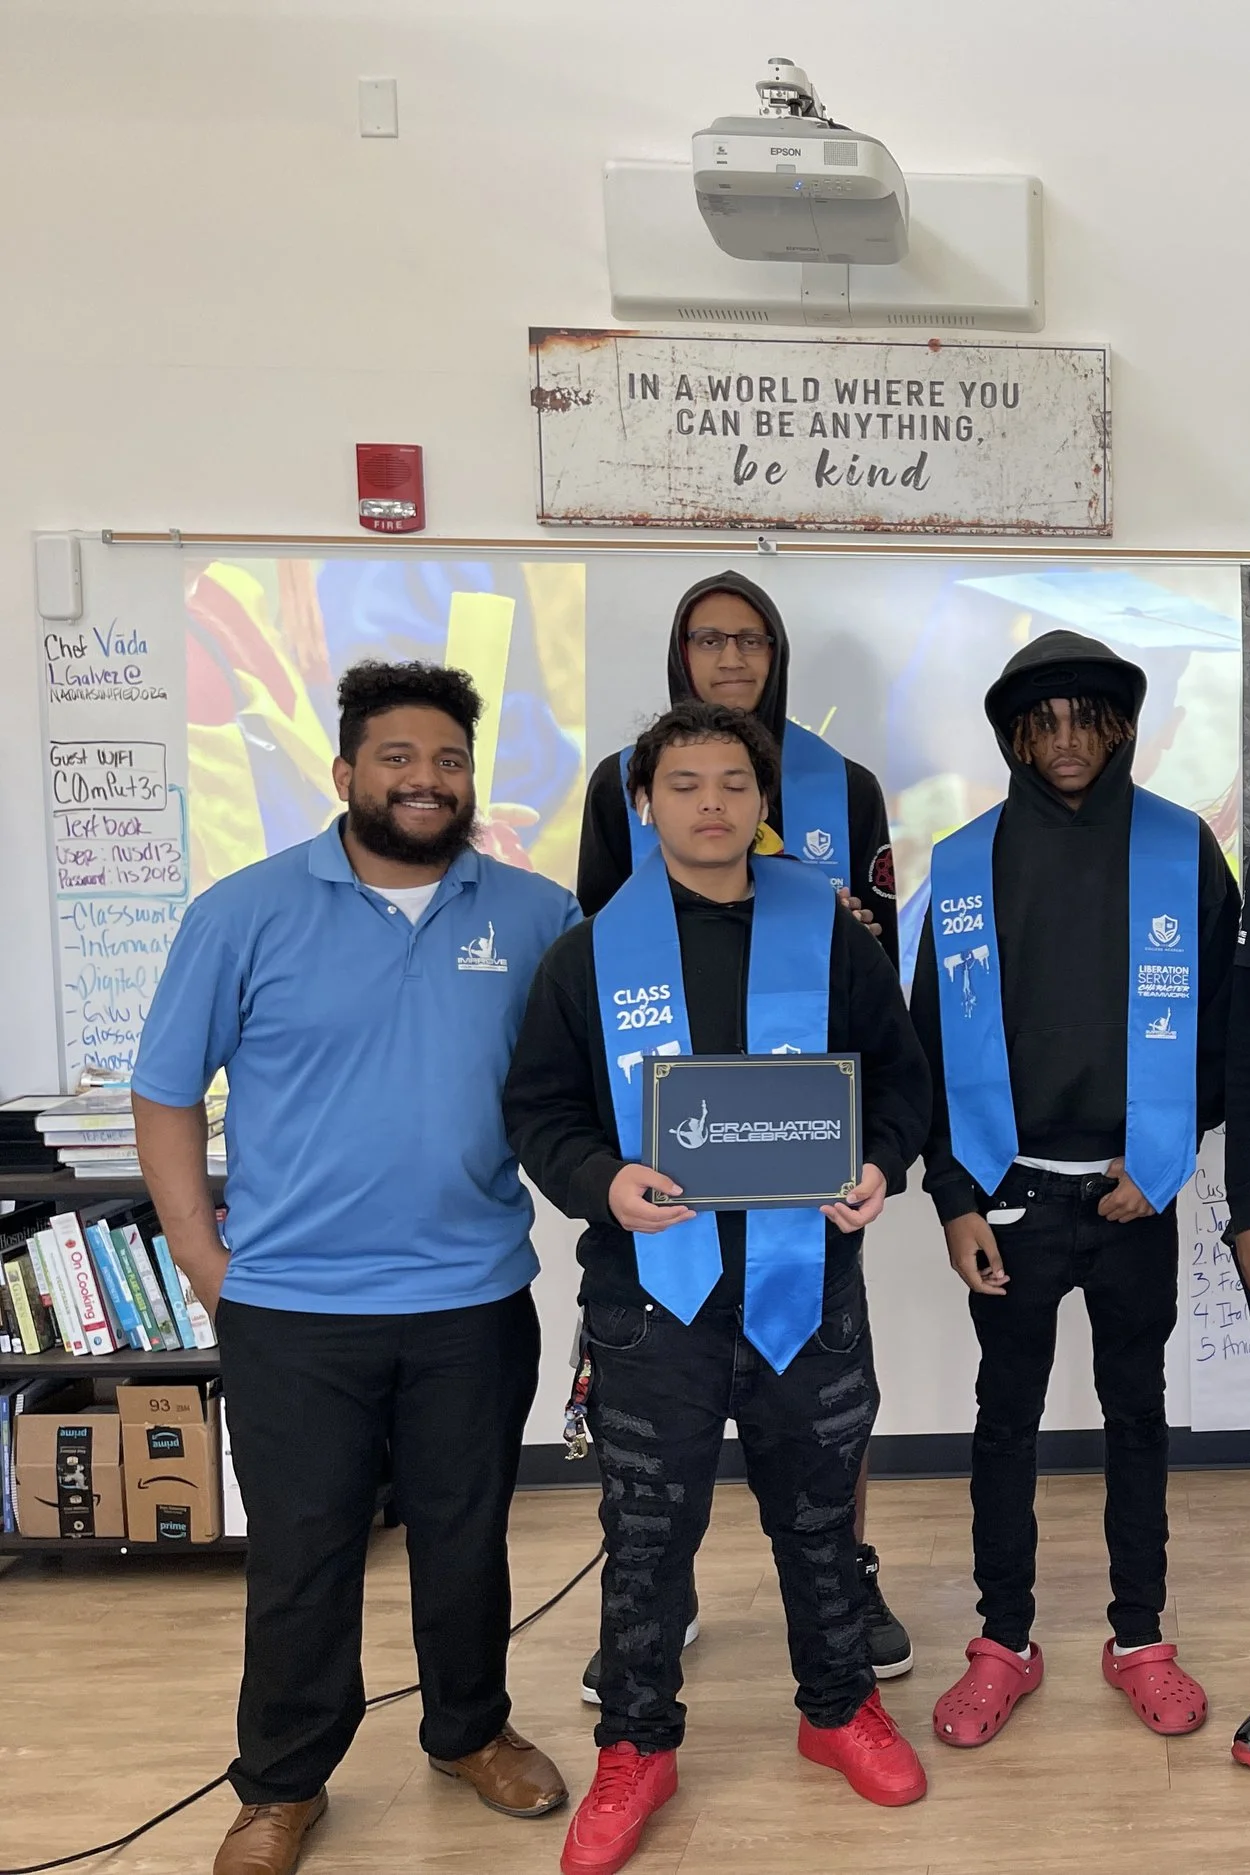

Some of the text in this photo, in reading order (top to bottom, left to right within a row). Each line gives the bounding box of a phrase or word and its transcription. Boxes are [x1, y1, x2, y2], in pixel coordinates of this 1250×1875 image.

[770, 148, 801, 157] EPSON
[628, 373, 1021, 409] IN A WORLD WHERE YOU
[676, 408, 985, 445] CAN BE ANYTHING,
[733, 444, 931, 491] be kind
[374, 521, 403, 530] FIRE
[50, 746, 133, 768] Guest WIFI
[940, 895, 983, 914] CLASS
[942, 914, 984, 935] 2024
[1139, 965, 1190, 975] LIBERATION
[1138, 973, 1190, 986] SERVICE
[613, 985, 671, 1006] CLASS
[1137, 984, 1191, 993] CHARACTER
[616, 1005, 674, 1031] 2024
[709, 1119, 841, 1134] GRADUATION
[709, 1130, 841, 1144] CELEBRATION
[71, 1251, 95, 1319] On Cooking
[149, 1399, 171, 1412] 93
[60, 1428, 87, 1439] prime
[152, 1439, 179, 1449] prime
[160, 1521, 186, 1532] prime
